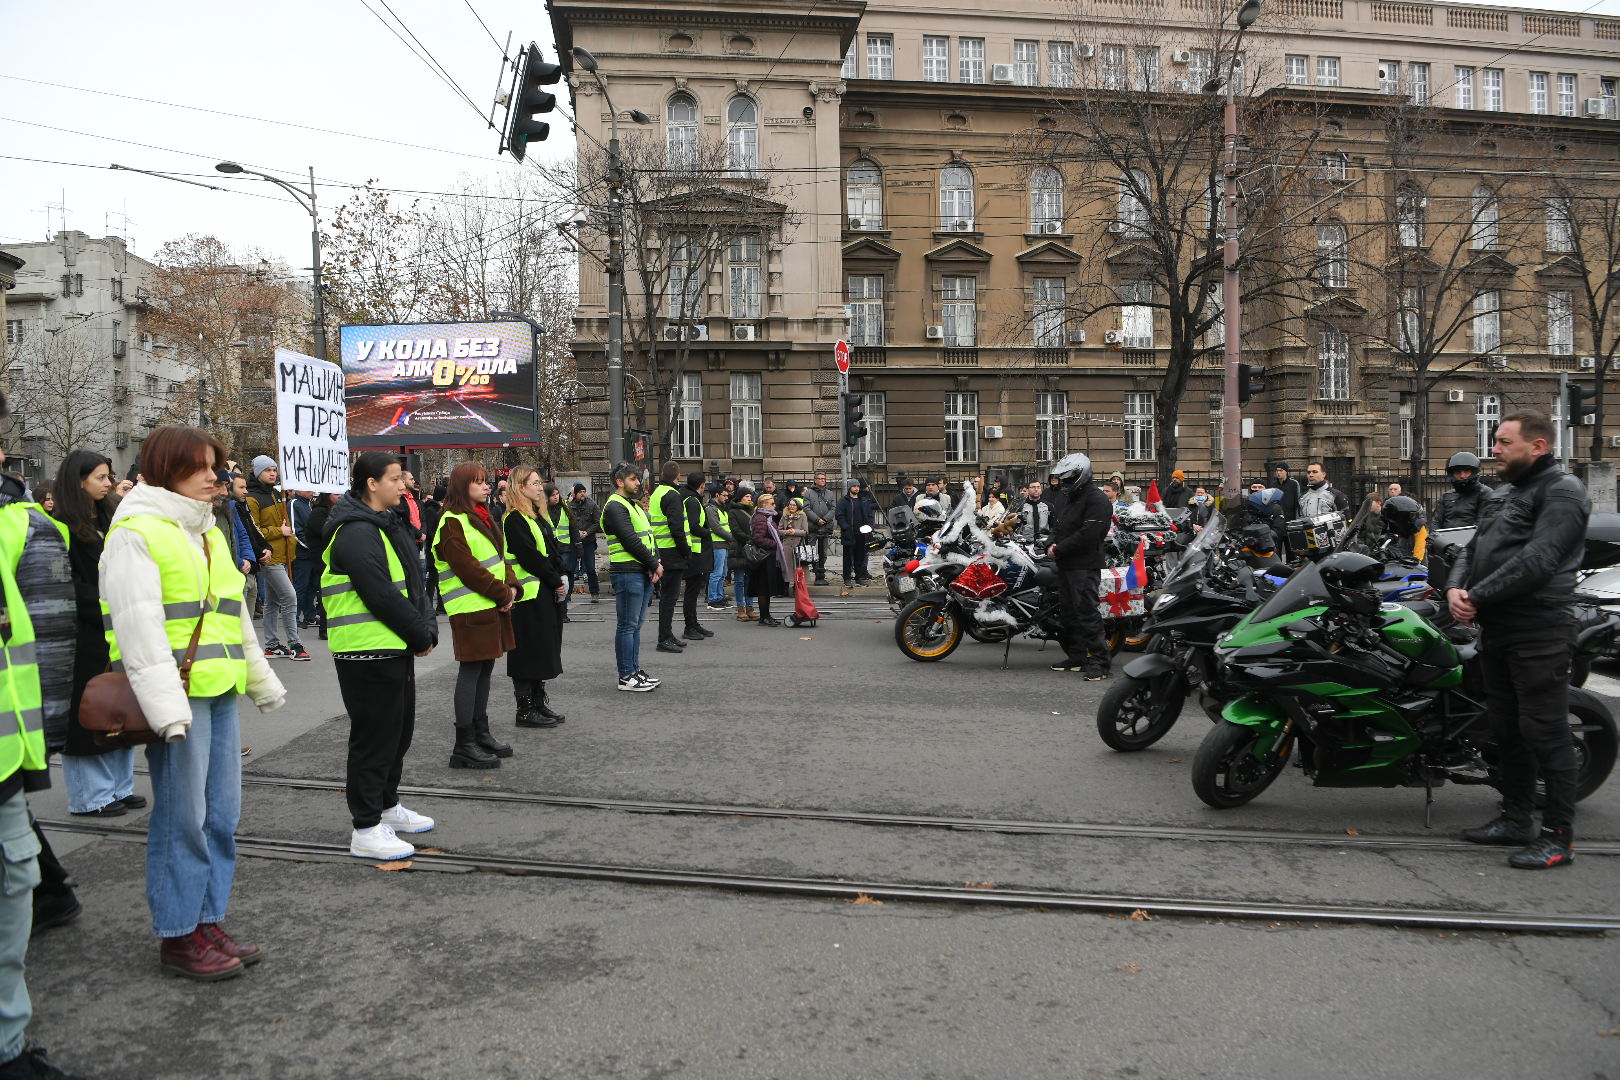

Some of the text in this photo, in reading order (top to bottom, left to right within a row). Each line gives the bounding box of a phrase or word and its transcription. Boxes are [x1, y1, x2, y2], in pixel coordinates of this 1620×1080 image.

[357, 338, 500, 361] У КОЛА БЕЗ
